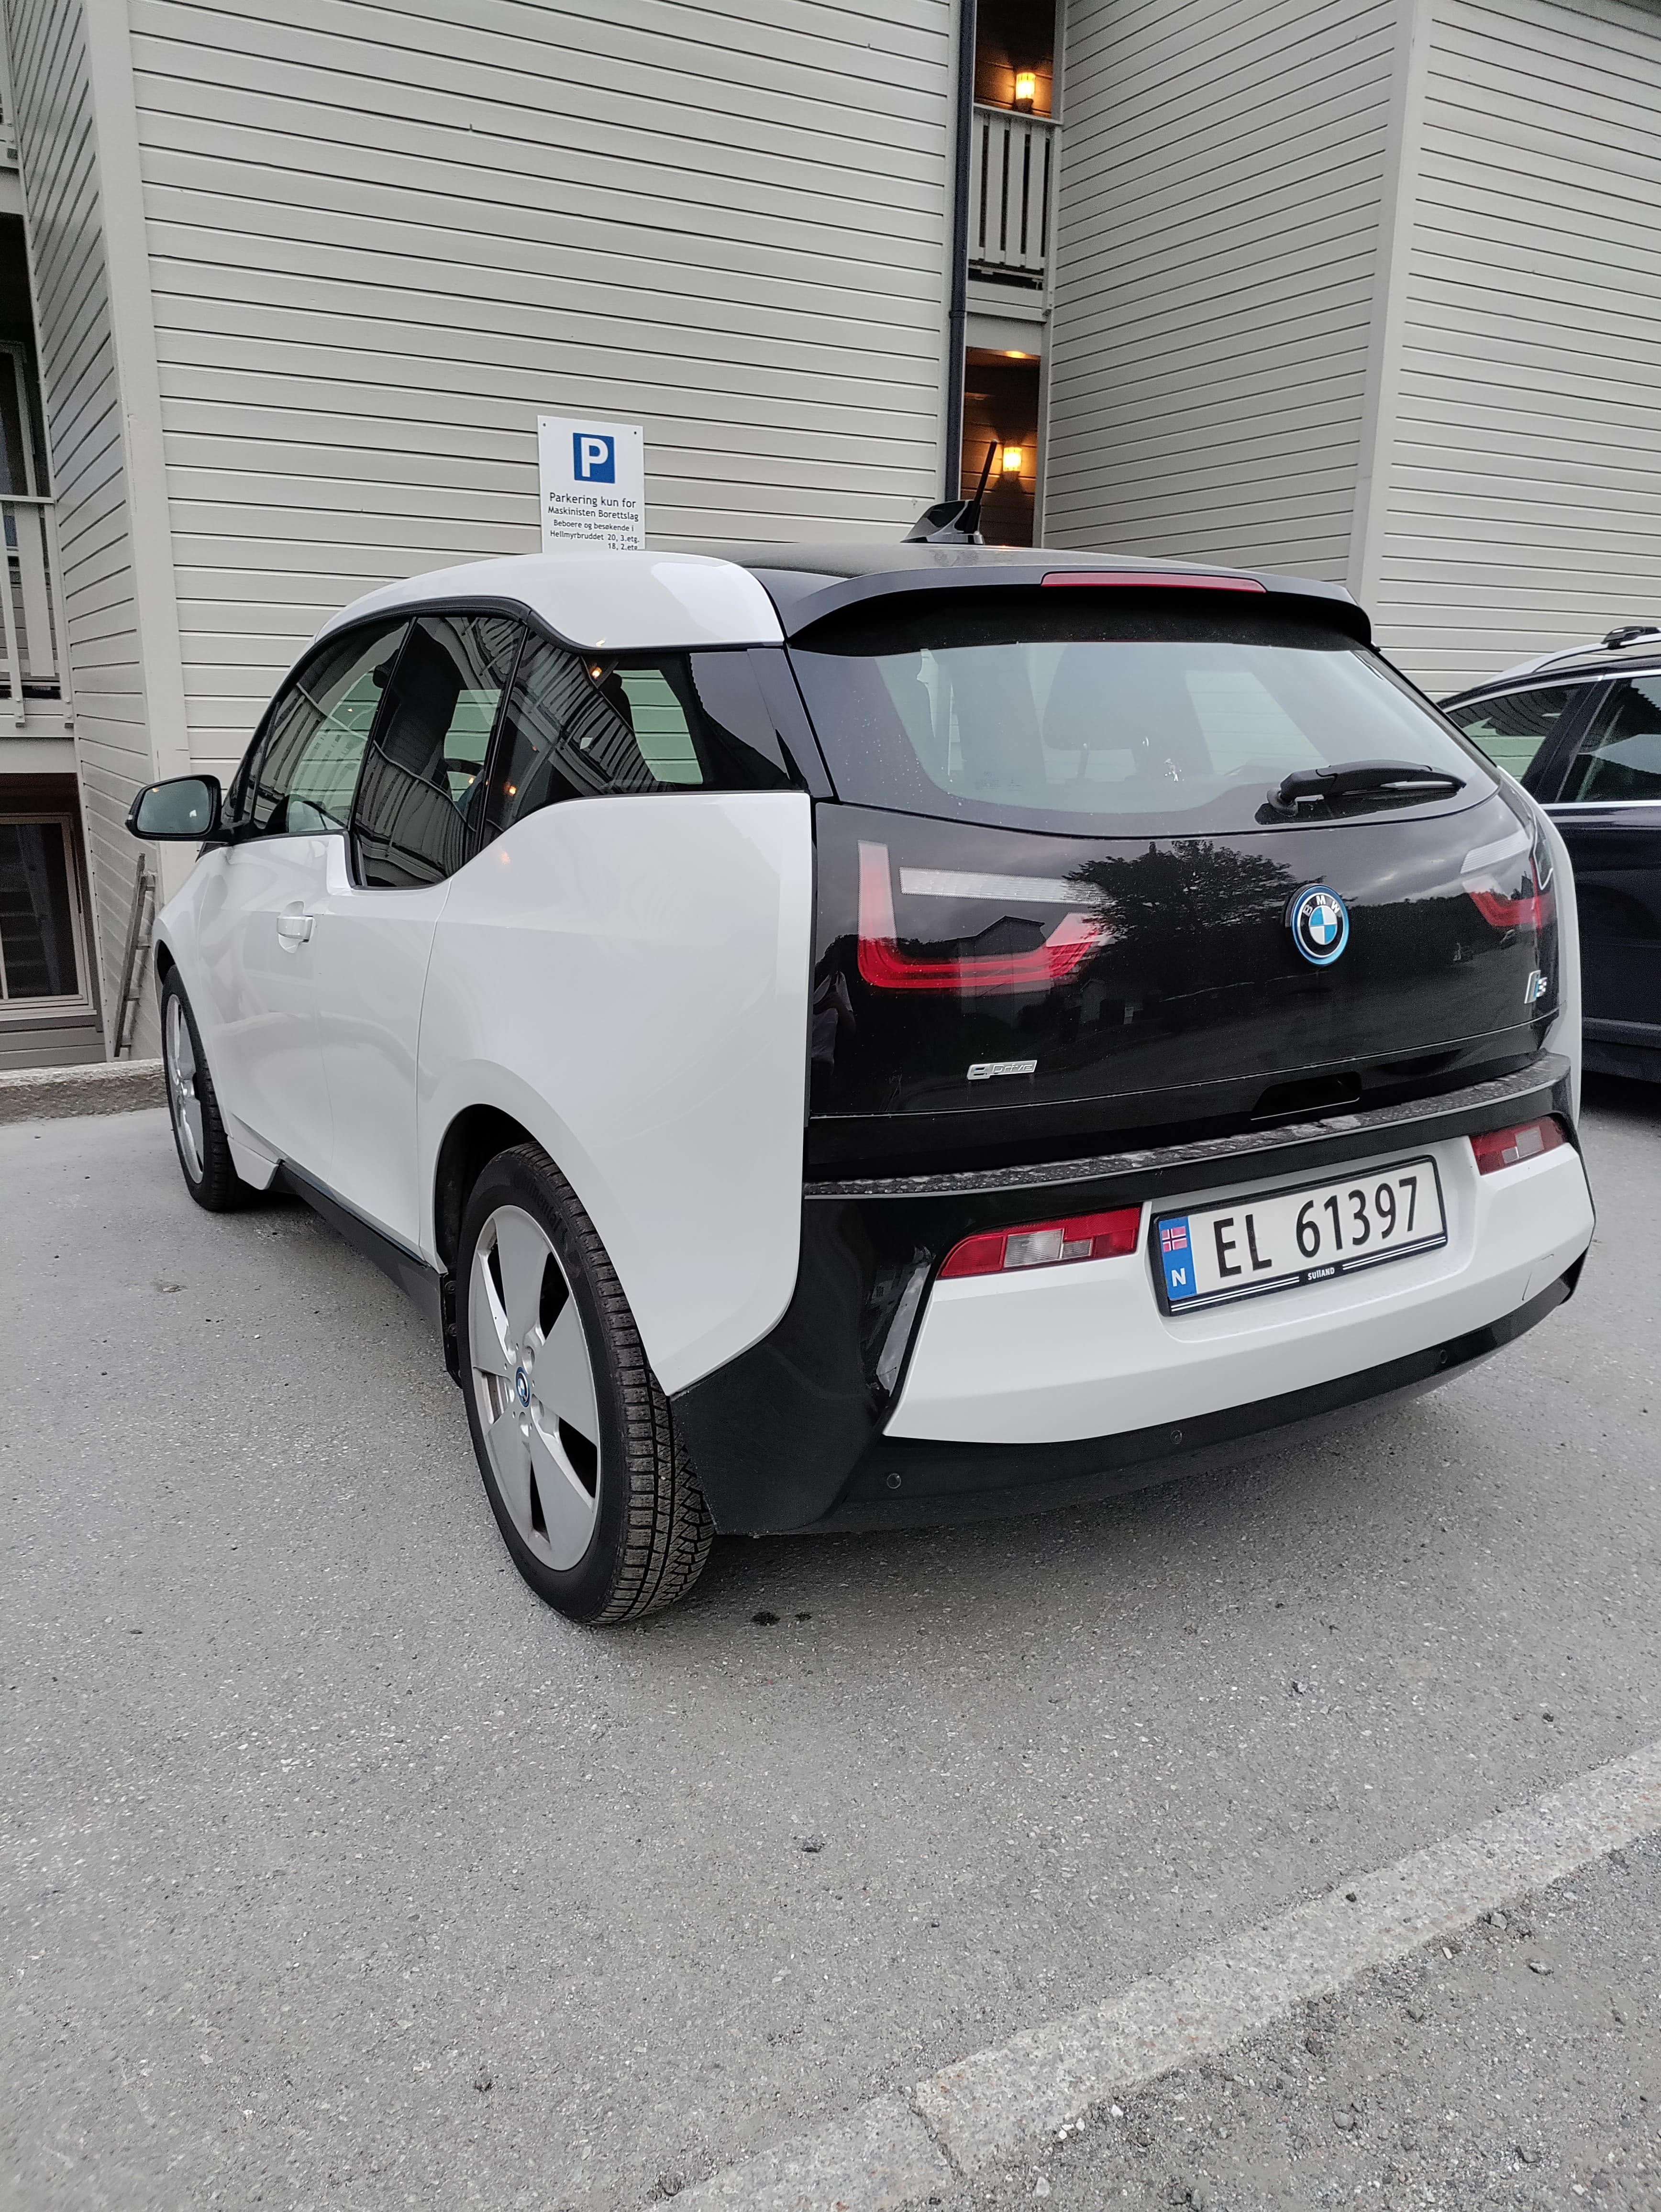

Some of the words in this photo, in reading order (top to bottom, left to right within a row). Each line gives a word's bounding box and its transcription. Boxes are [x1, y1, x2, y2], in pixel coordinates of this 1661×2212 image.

[581, 437, 609, 477] P
[550, 492, 598, 507] Parkering
[601, 496, 619, 507] kun
[622, 498, 636, 508] for
[548, 506, 596, 517] Maskinisten
[598, 510, 639, 522] Borettslag
[554, 520, 582, 528] Beboere
[594, 522, 630, 531] besøkende
[550, 530, 604, 540] Hellmyrbruddet
[607, 534, 618, 542] 20,
[1302, 895, 1340, 917] BMW
[1213, 1214, 1273, 1278] EL
[1296, 1175, 1417, 1259] 61397
[1171, 1267, 1186, 1287] N
